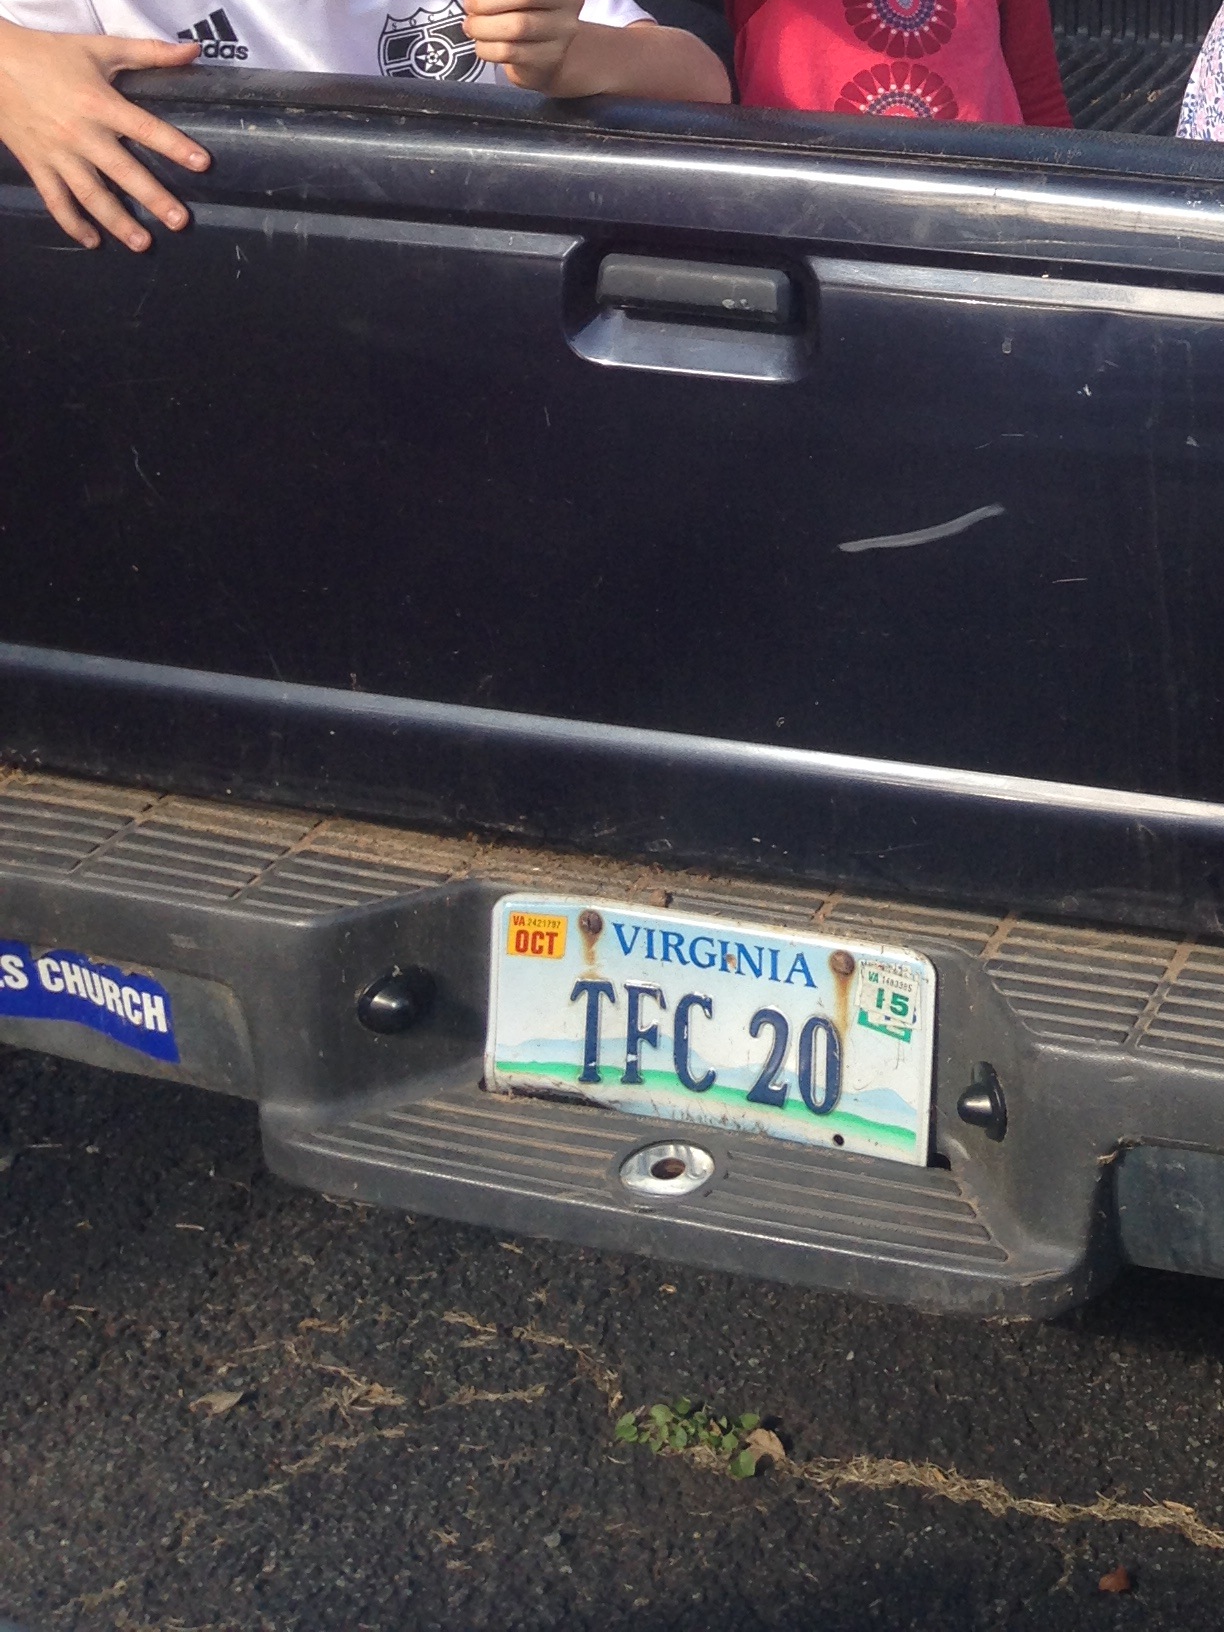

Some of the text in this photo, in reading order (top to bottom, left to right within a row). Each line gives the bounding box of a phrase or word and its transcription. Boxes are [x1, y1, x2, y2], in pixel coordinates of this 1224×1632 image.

[513, 915, 526, 927] VA
[515, 929, 559, 956] OCT
[612, 922, 819, 989] VIRGINIA
[868, 970, 879, 984] VA
[37, 957, 168, 1033] CHURCH
[876, 987, 910, 1017] 15
[570, 979, 843, 1116] TFC 20
